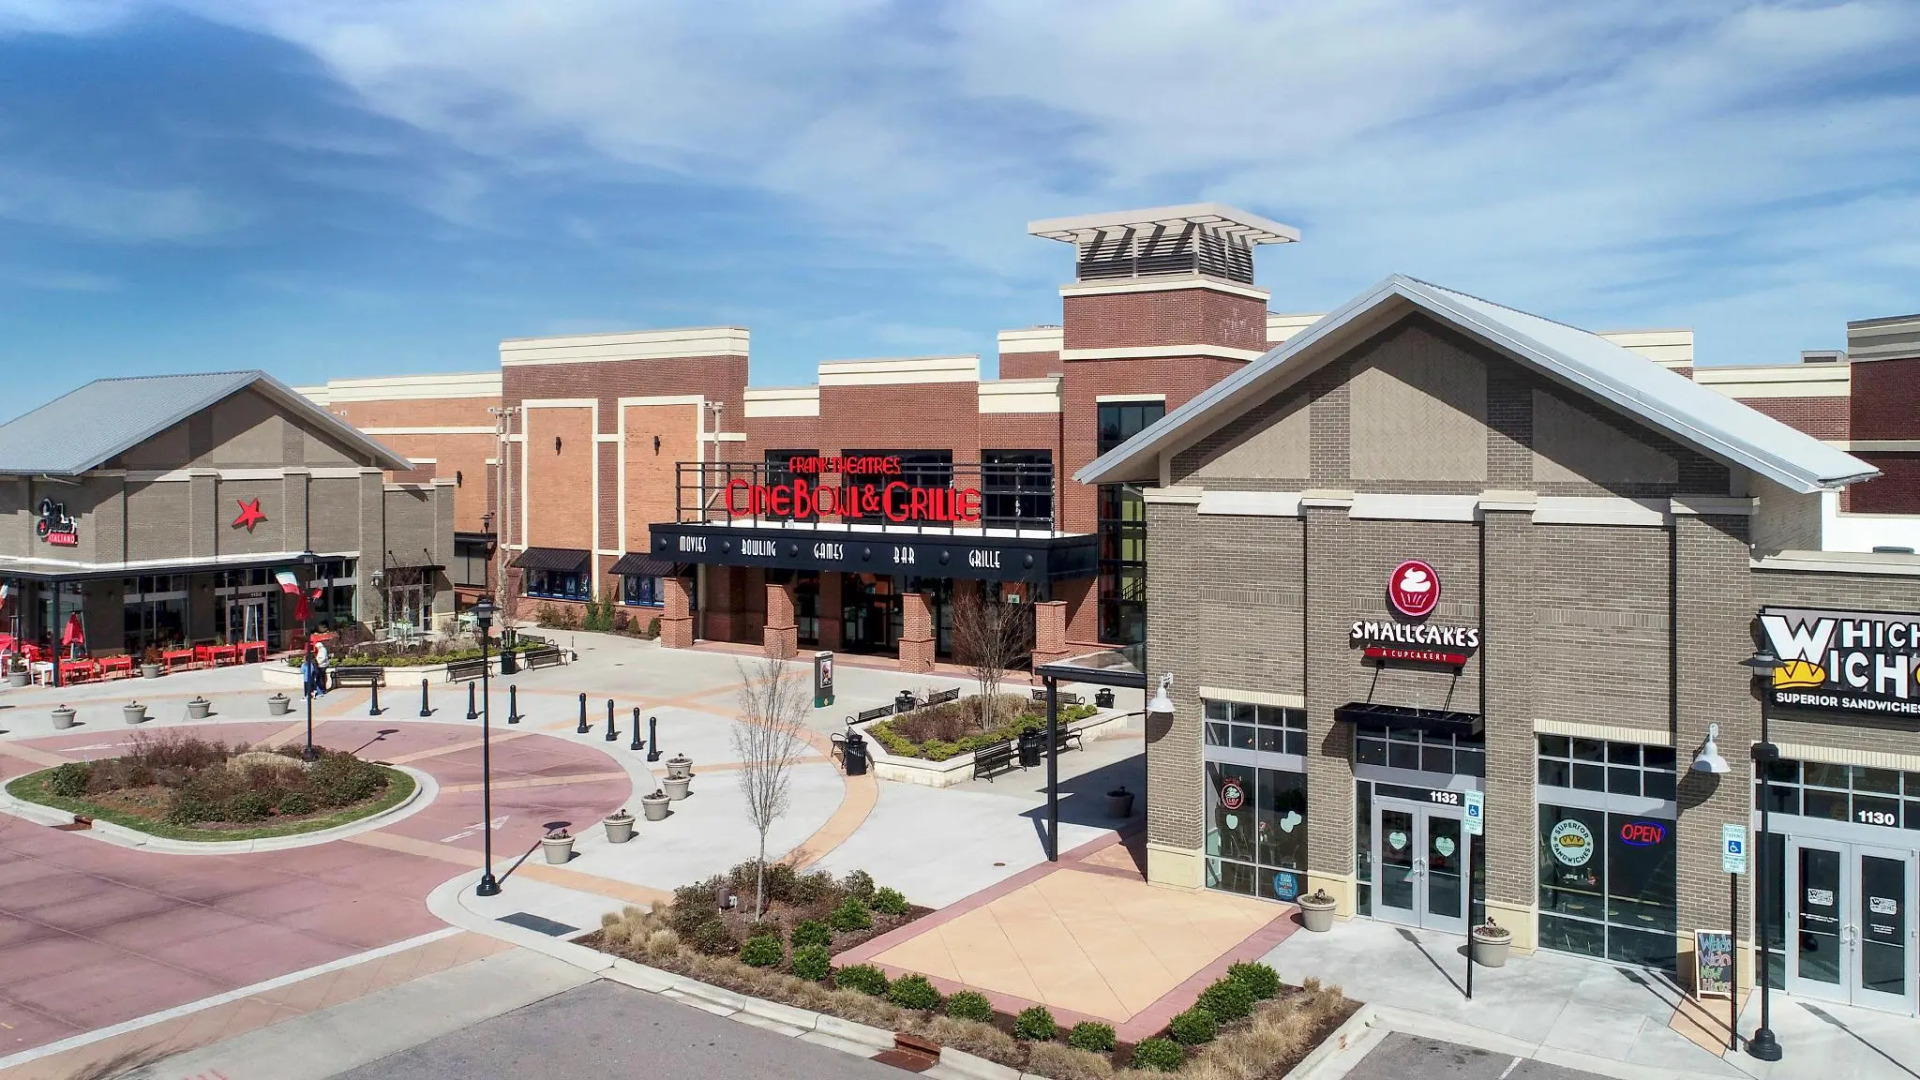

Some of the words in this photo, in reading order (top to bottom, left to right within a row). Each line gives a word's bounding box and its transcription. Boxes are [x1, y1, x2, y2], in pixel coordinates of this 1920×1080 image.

[830, 456, 901, 475] THEATRES
[883, 481, 980, 522] GRILLE
[679, 536, 707, 553] MOVIES
[741, 539, 776, 557] BOWLING
[813, 543, 844, 561] GAMES
[893, 546, 915, 564] BAR
[969, 549, 1000, 568] GRILLE
[1352, 620, 1479, 648] SMALLCAKES
[1391, 650, 1448, 661] CUPCAKERY
[1776, 692, 1838, 707] SUPERIOR
[1842, 698, 1920, 714] SANDWICHE
[1430, 790, 1458, 805] 1132
[1858, 810, 1895, 826] 1130
[1554, 822, 1589, 839] SUPERIOR
[1621, 823, 1662, 845] OPEN
[1553, 843, 1591, 864] SANDWICHES
